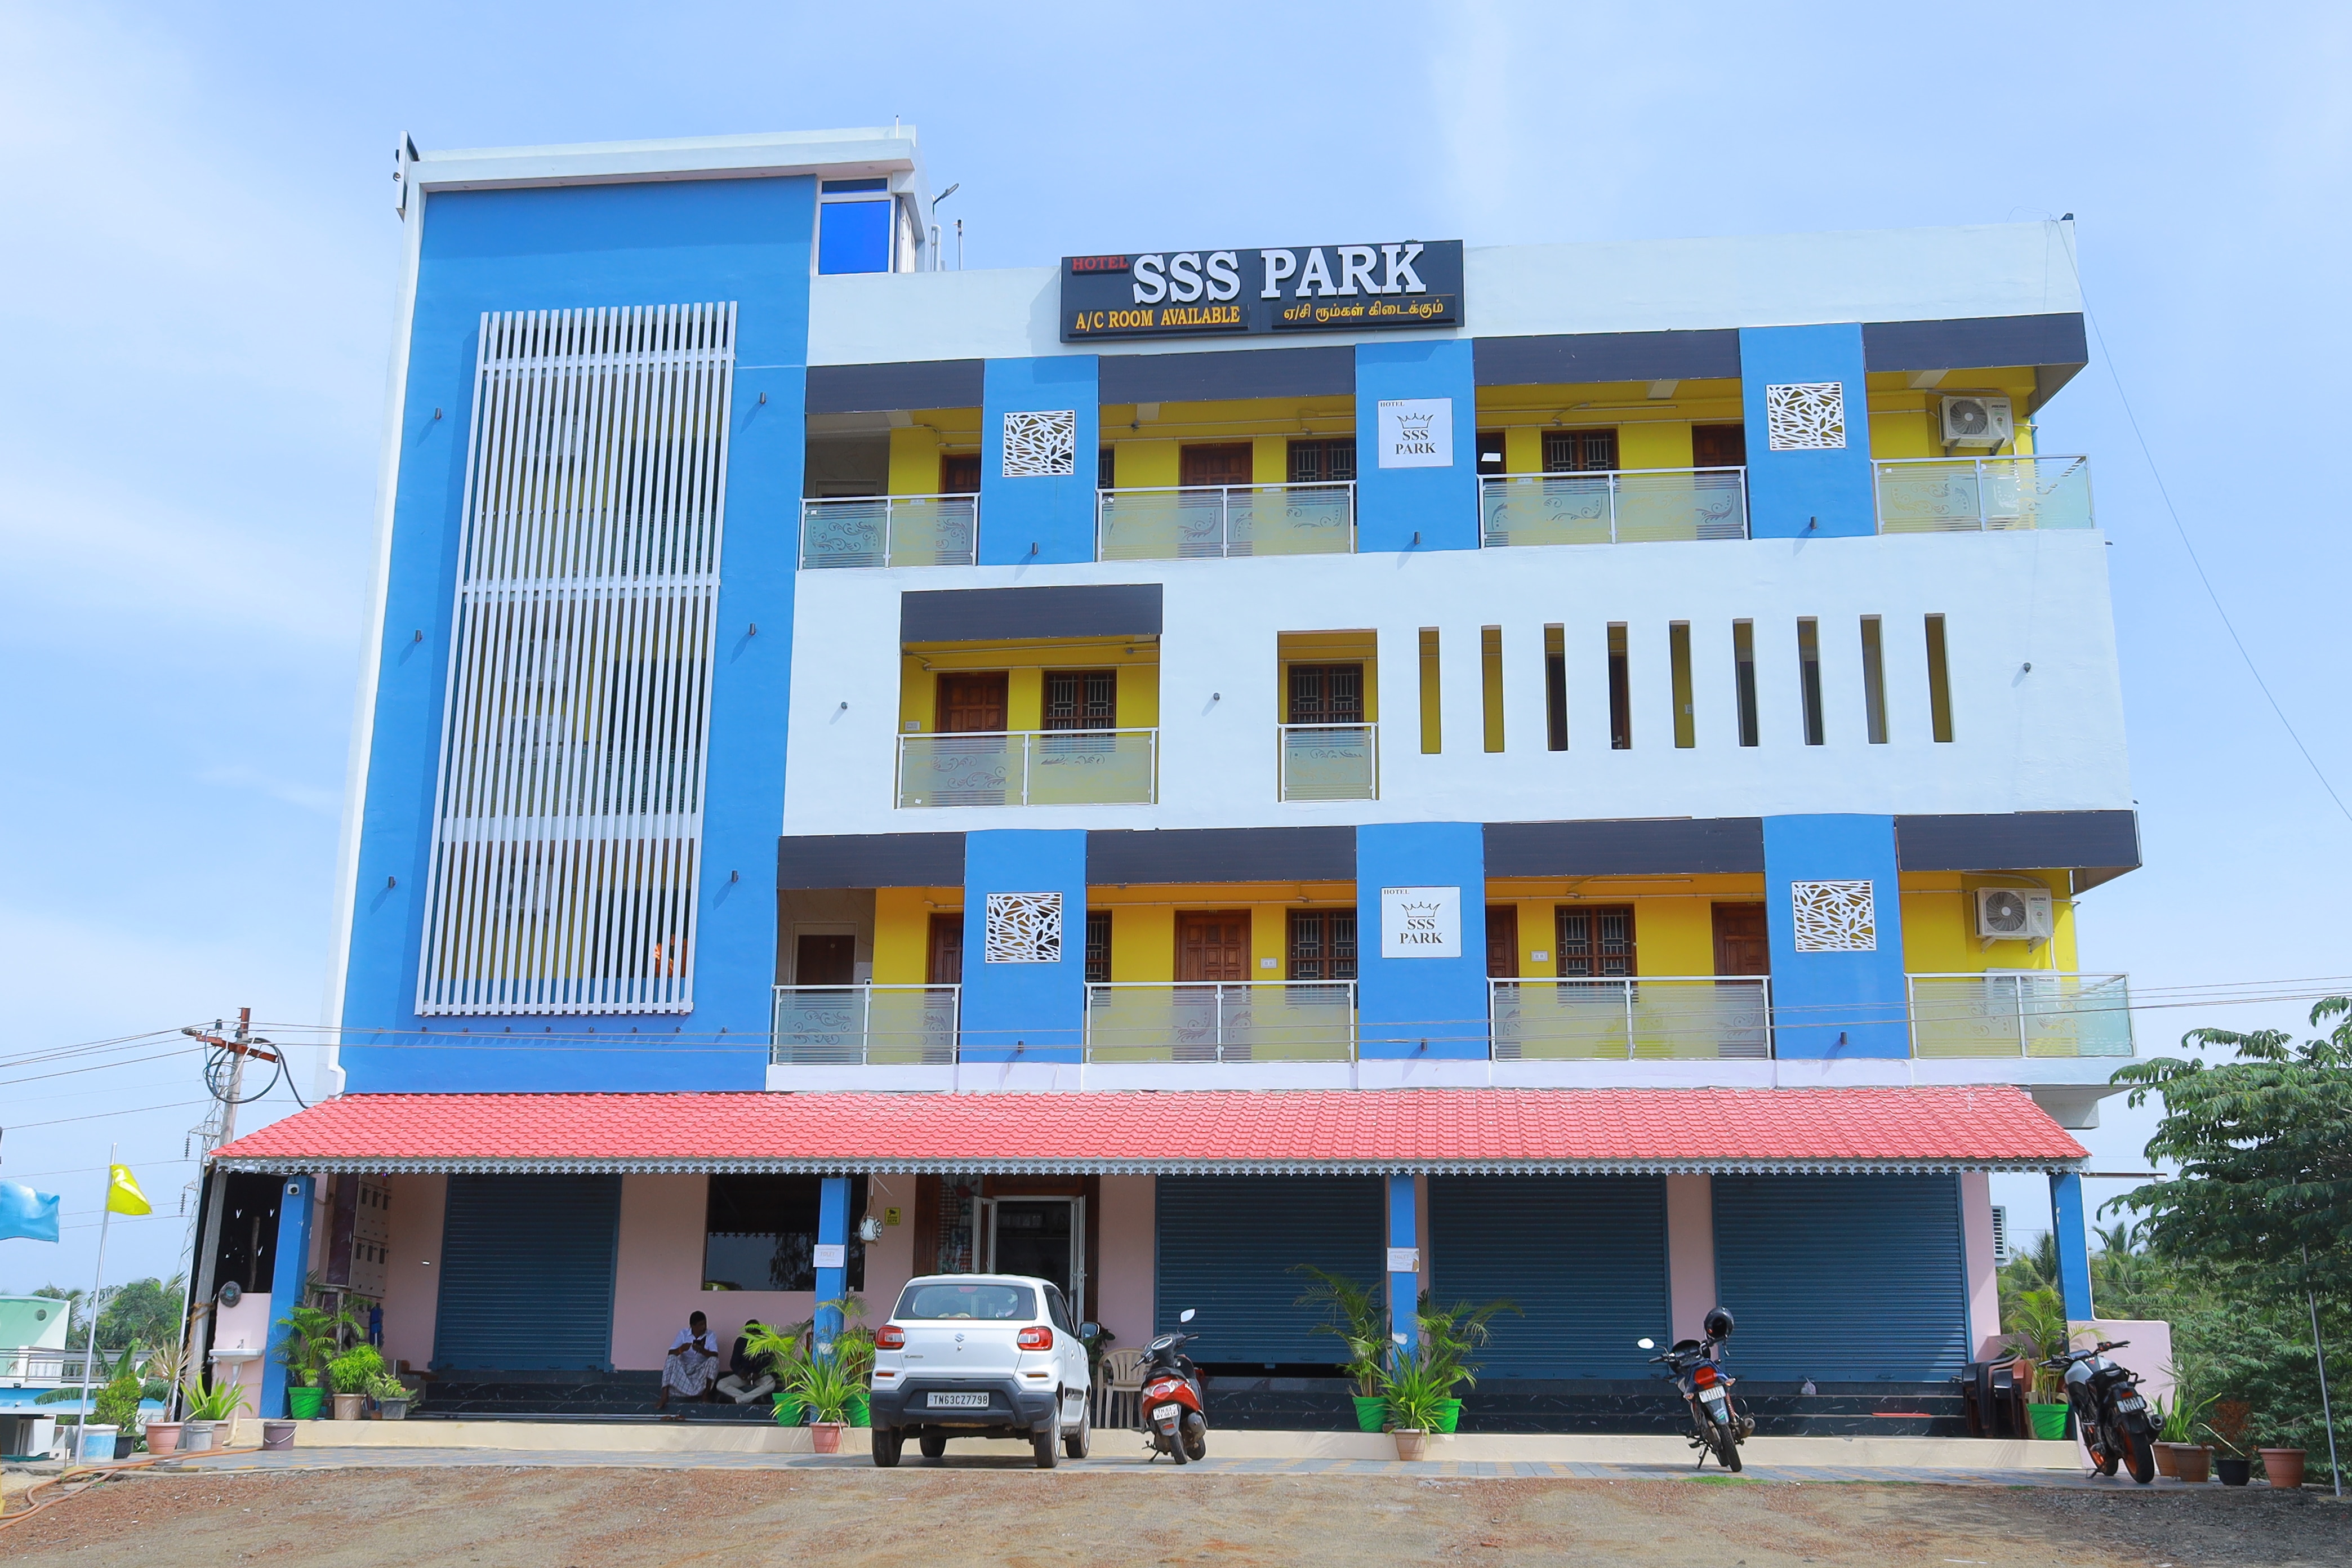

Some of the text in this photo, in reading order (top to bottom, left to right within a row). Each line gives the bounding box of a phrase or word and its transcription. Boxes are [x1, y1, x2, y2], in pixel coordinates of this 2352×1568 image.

[1072, 256, 1129, 270] HOTEL
[1132, 243, 1427, 304] SSS PARK
[1368, 299, 1444, 319] கிடைக்கும்
[1075, 305, 1240, 332] A/C ROOM AVAILABLE
[1402, 429, 1428, 441] SSS
[1395, 442, 1436, 455] PARK
[1407, 919, 1435, 930] SSS
[1400, 932, 1444, 944] PARK
[934, 1395, 988, 1405] TN63CZ7798
